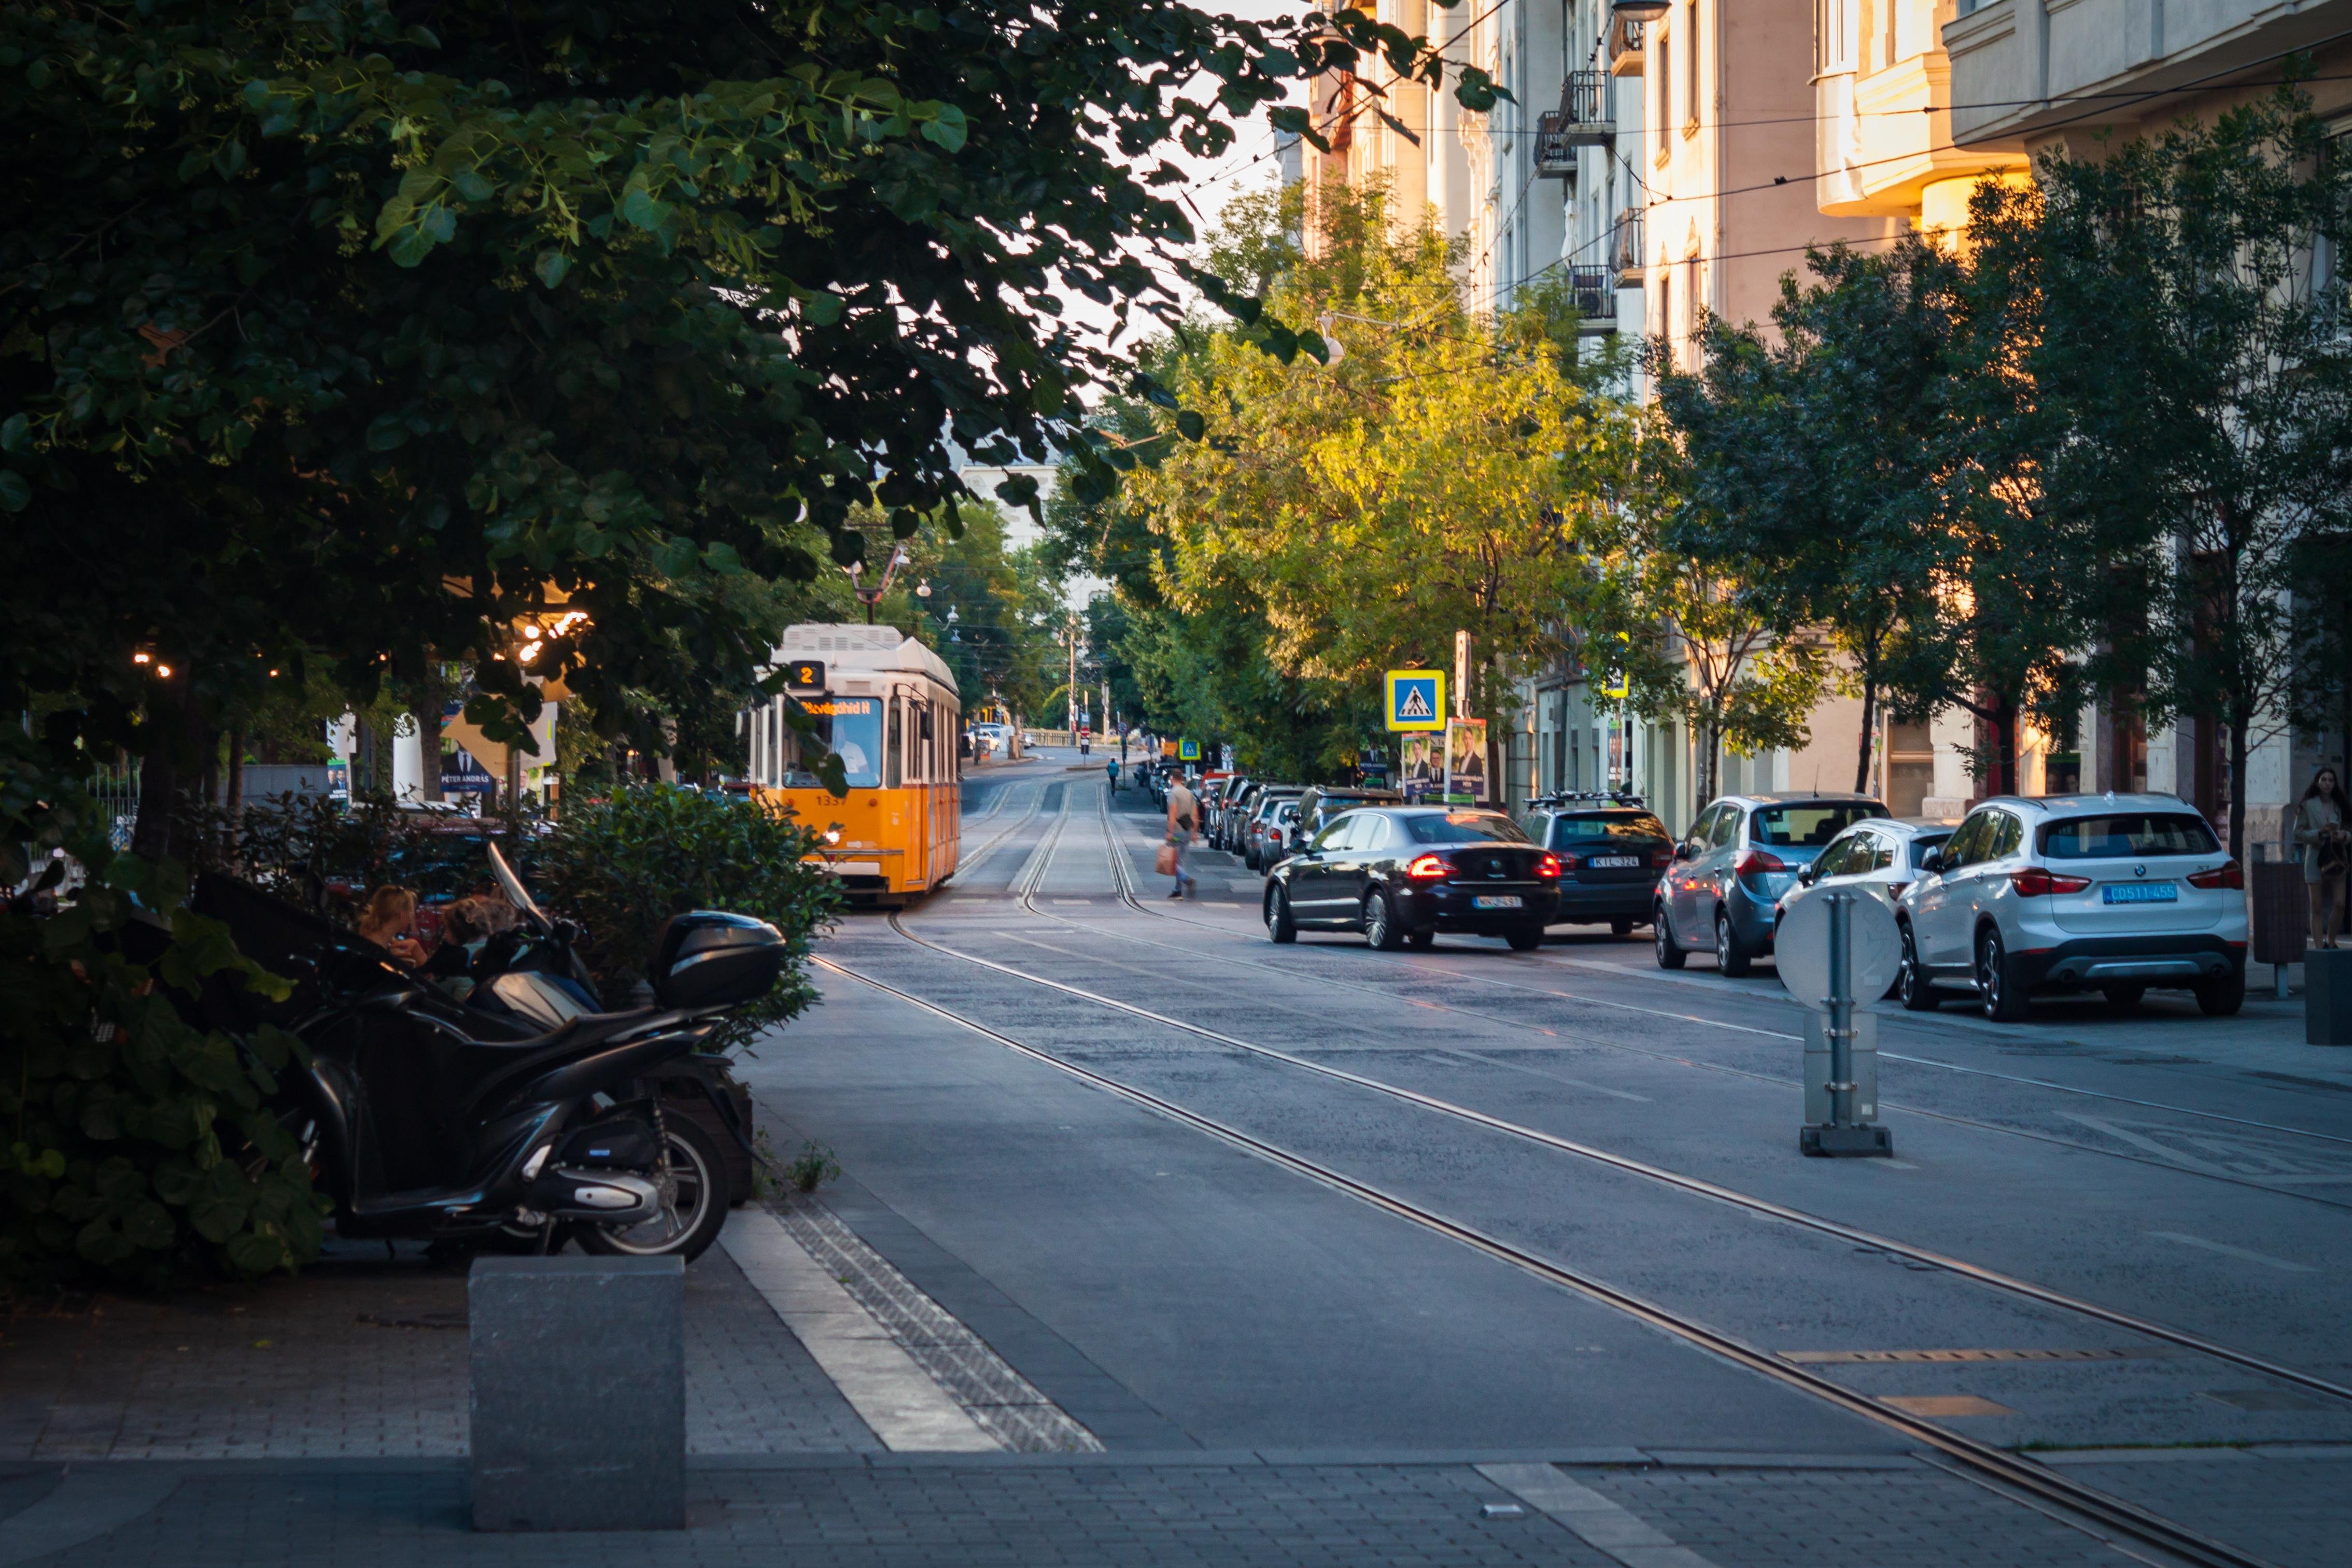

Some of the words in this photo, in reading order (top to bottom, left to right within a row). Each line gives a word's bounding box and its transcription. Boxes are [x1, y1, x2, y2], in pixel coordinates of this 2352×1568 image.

[800, 667, 813, 683] 2
[862, 701, 870, 714] H
[441, 773, 461, 783] PÉTER
[462, 773, 489, 783] ANDRÁS
[1596, 856, 1637, 866] KIL-324
